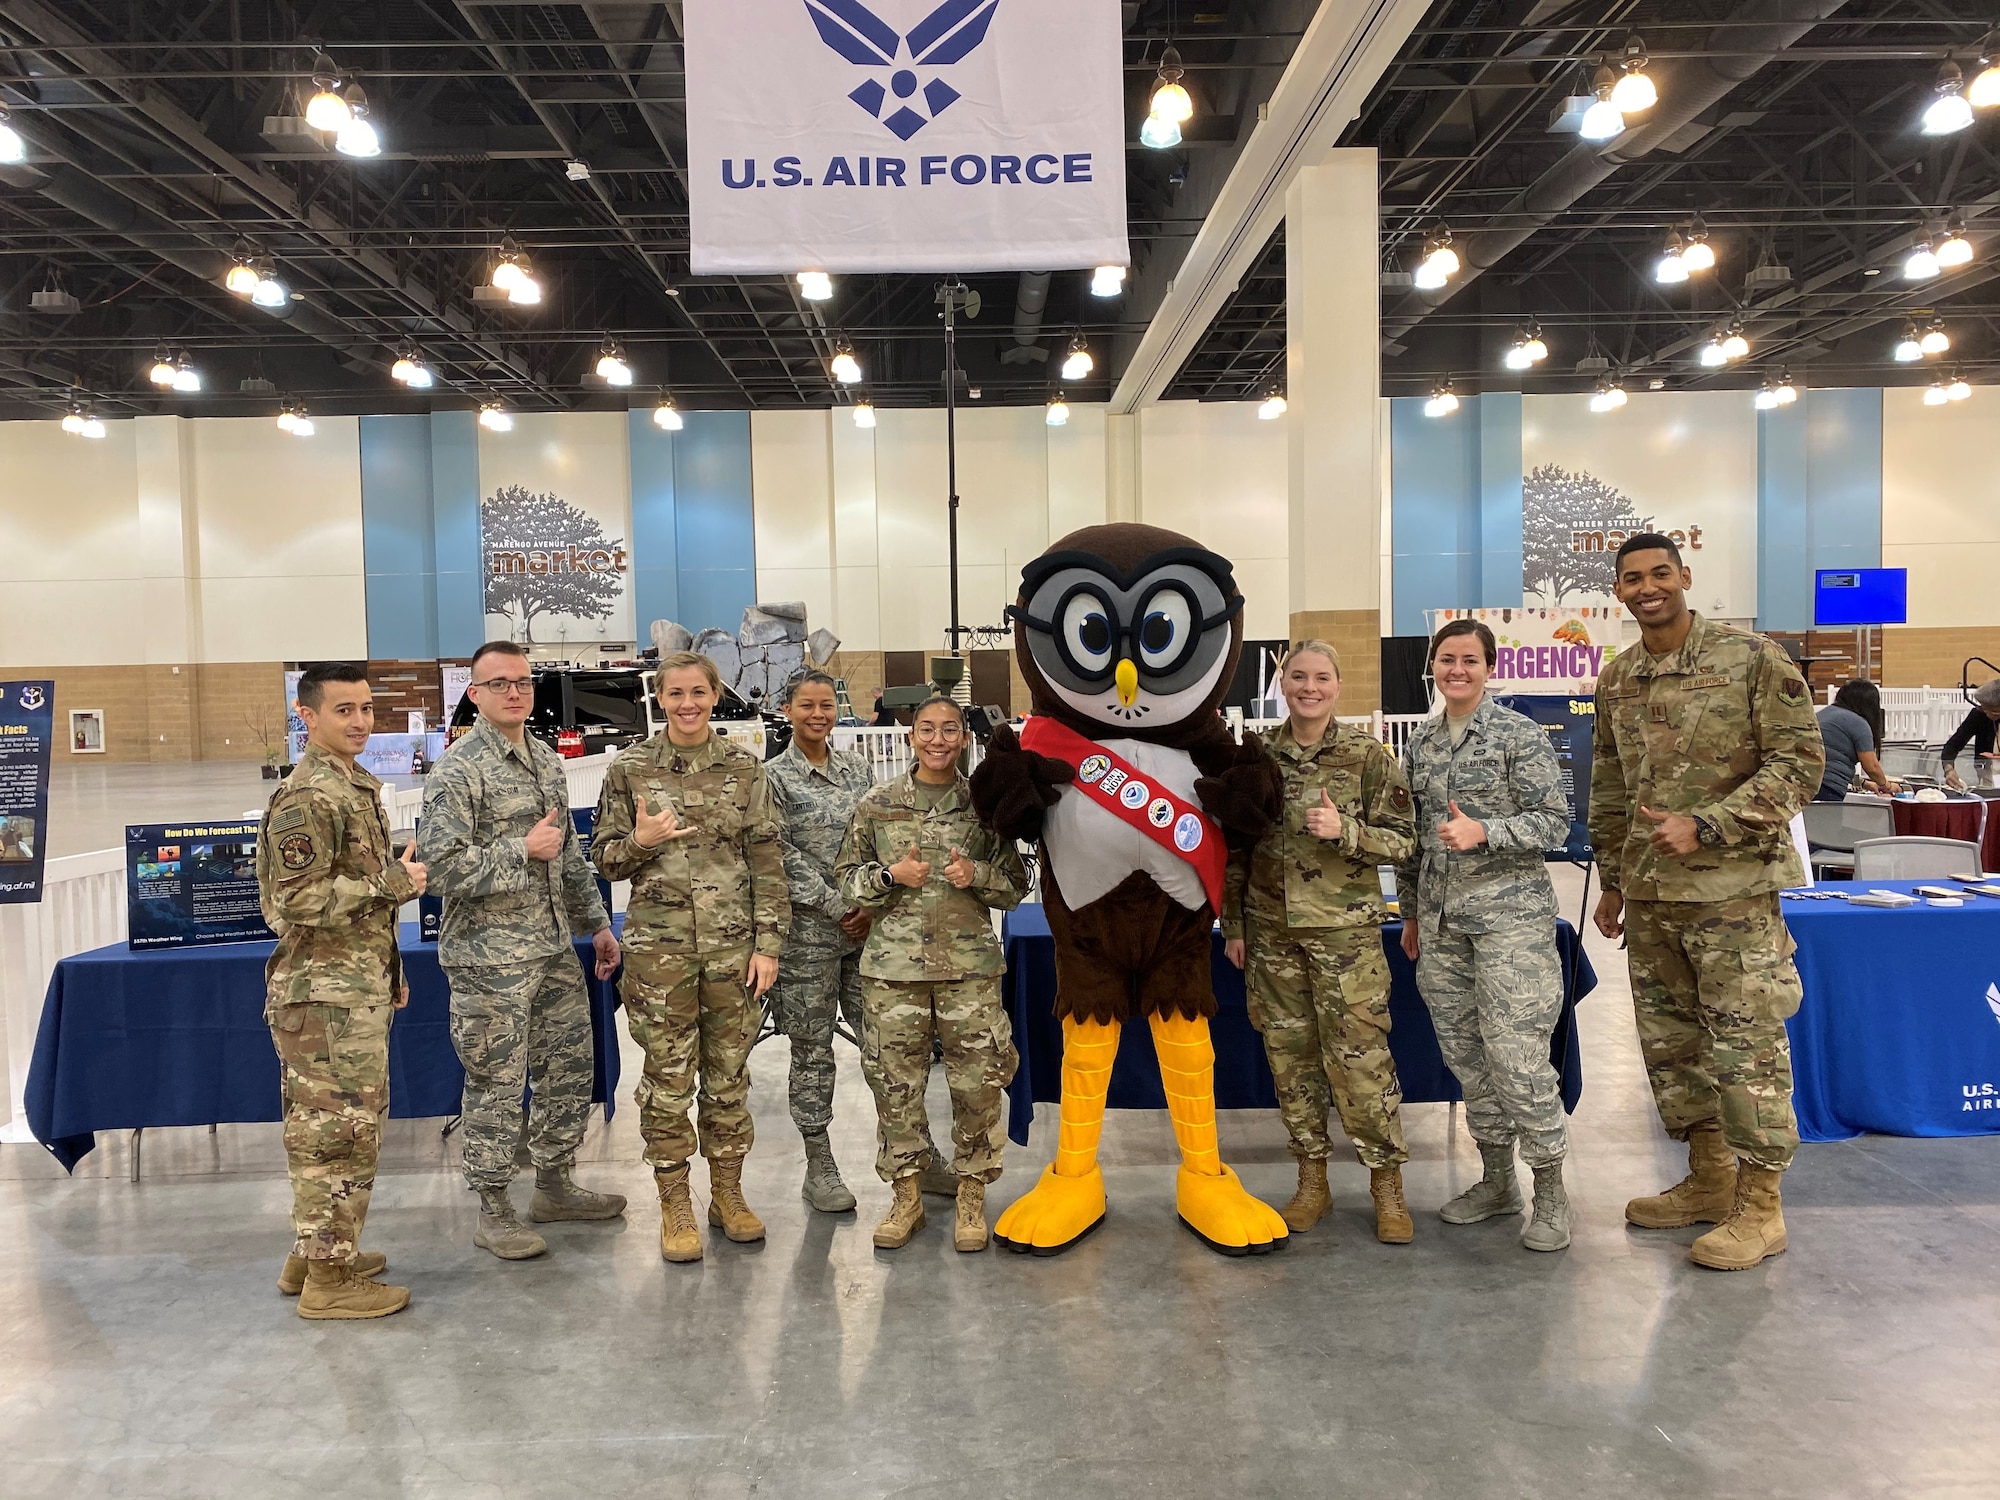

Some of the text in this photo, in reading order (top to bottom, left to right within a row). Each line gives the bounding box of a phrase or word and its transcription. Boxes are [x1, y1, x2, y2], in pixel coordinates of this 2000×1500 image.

[722, 152, 1093, 188] U.S. AIR FORCE
[1607, 520, 1644, 528] STREET
[492, 540, 531, 548] MARENGO
[492, 544, 629, 574] market
[1695, 679, 1704, 687] AIR
[1706, 676, 1726, 685] FORCE
[4, 725, 28, 734] Facts
[1106, 772, 1125, 794] NOW
[165, 830, 182, 838] How
[209, 826, 242, 835] Forecast
[1962, 1083, 1998, 1098] U.S.
[1962, 1099, 1993, 1112] AIR
